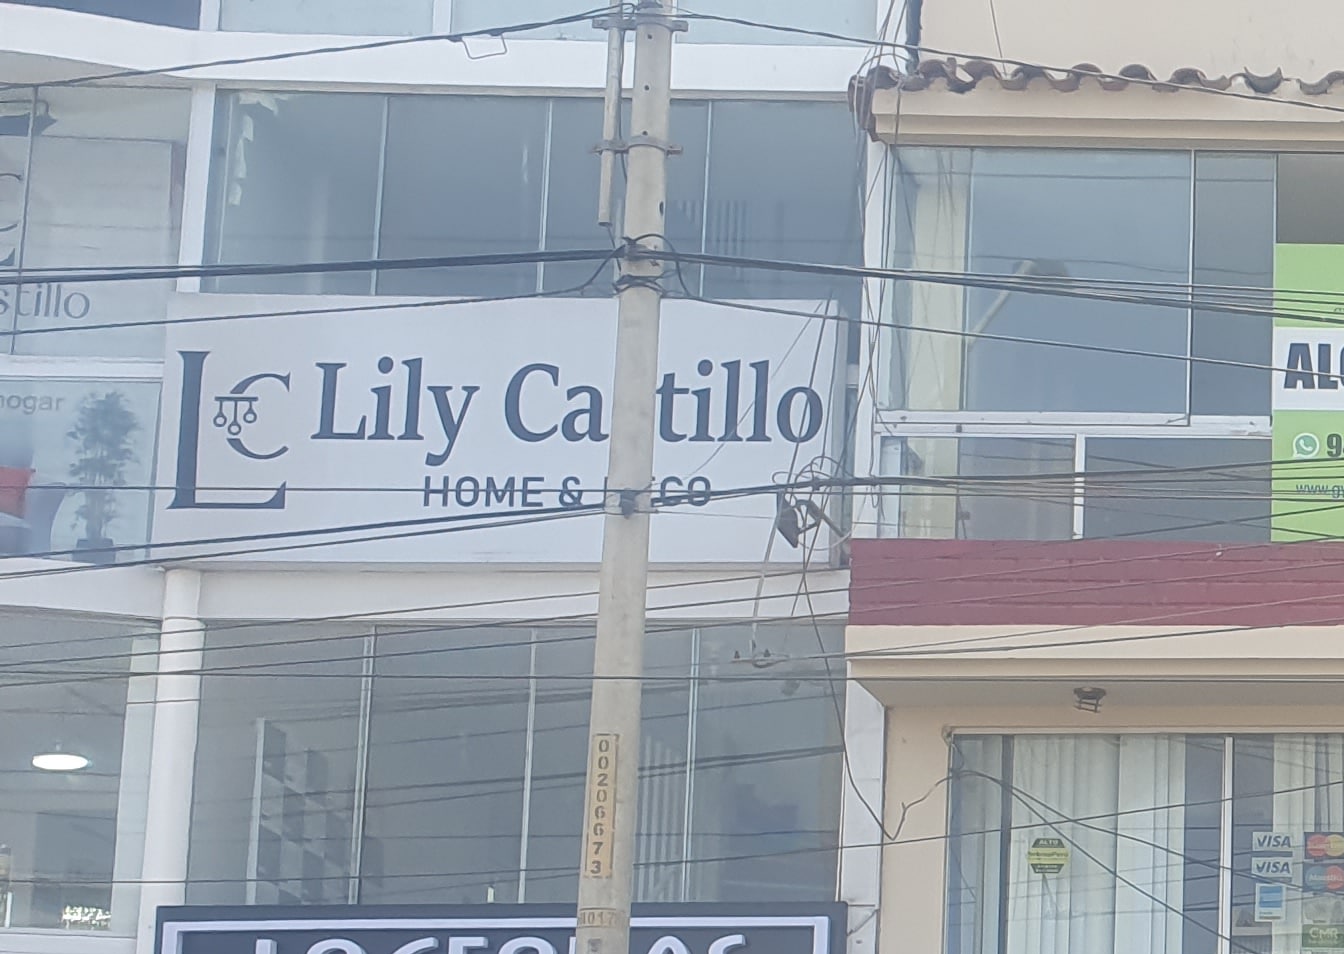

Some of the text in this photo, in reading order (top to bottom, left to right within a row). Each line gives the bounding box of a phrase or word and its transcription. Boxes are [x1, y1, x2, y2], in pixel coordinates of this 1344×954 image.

[311, 356, 824, 466] Lily Catillo
[423, 476, 545, 507] HOME
[559, 476, 583, 507] &
[1257, 835, 1291, 848] VISA
[1256, 861, 1290, 873] VISA
[1309, 928, 1338, 939] CMR
